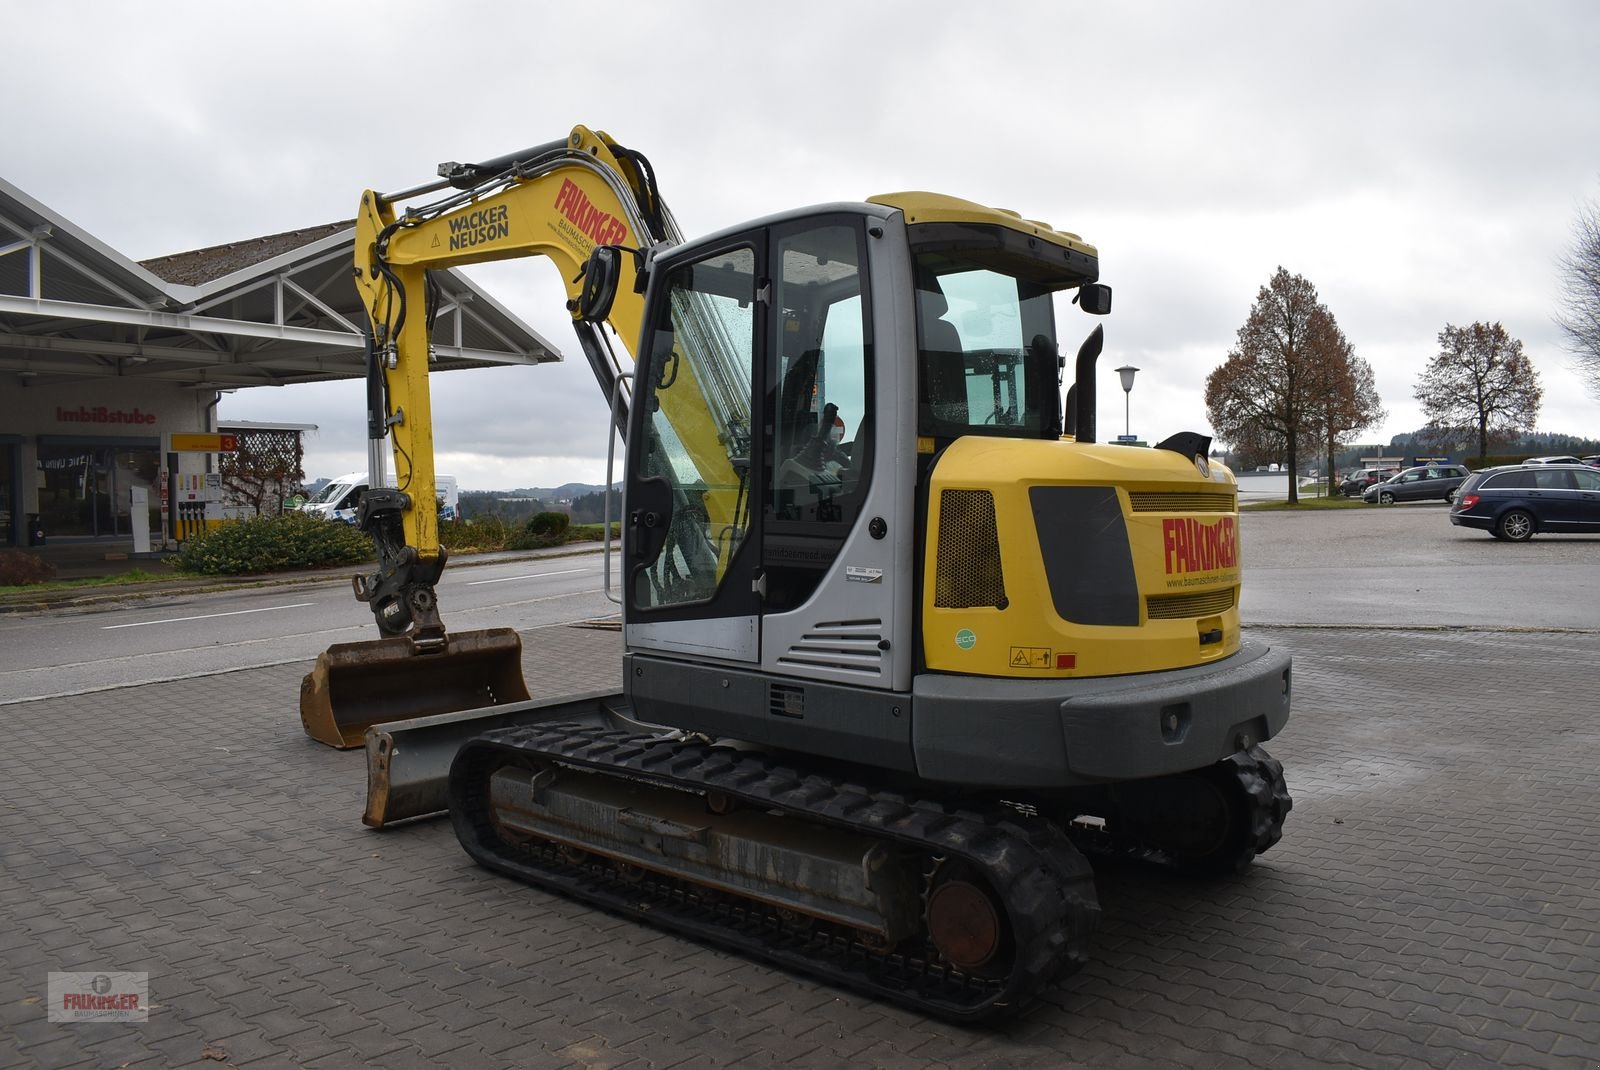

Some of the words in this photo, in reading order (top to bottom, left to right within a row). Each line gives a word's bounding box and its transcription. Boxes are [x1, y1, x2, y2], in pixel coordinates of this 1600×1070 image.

[448, 204, 508, 234] WACKER
[554, 177, 627, 246] FALKINGER
[449, 221, 509, 251] NEUSON
[558, 218, 593, 252] BAUMASCHI
[56, 406, 156, 424] Imbißstube
[224, 438, 233, 450] 3
[1162, 517, 1237, 574] FALKINGER
[955, 635, 976, 644] ECO
